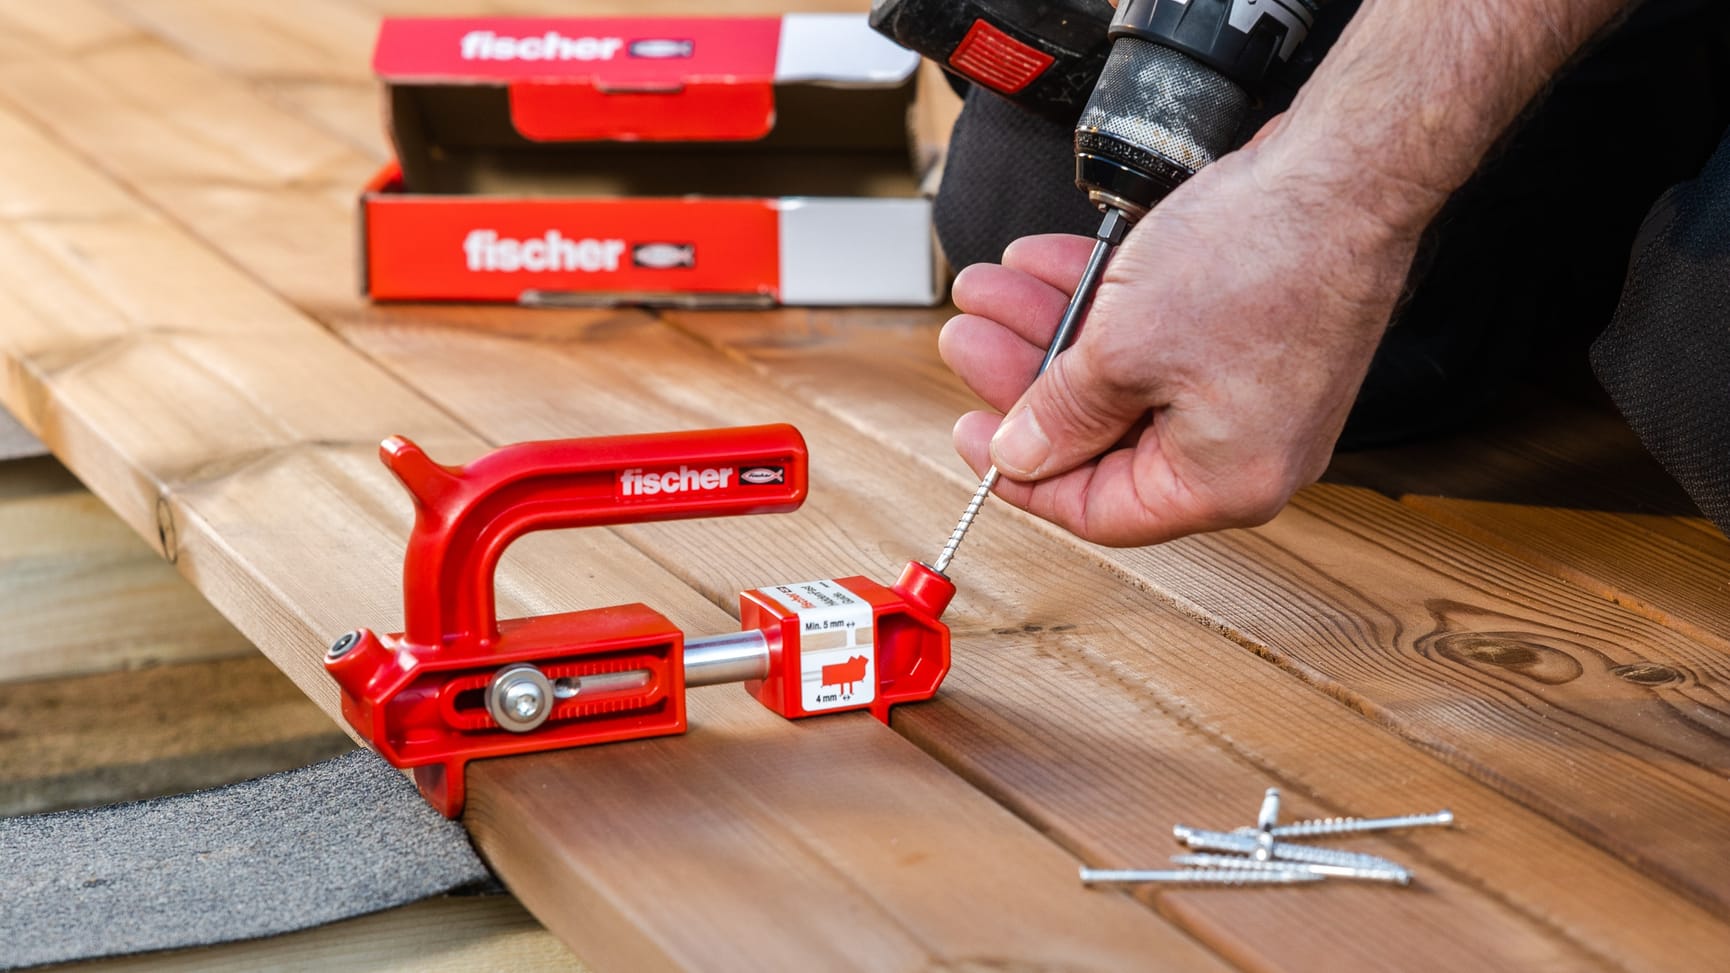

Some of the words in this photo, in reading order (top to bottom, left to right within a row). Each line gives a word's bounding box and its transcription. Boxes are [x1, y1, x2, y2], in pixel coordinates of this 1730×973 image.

[461, 31, 623, 60] fischer
[463, 229, 626, 272] fischer
[620, 465, 733, 496] fischer
[805, 622, 822, 631] Min.
[823, 620, 829, 629] 5
[829, 620, 844, 628] mm
[815, 694, 822, 703] 4
[822, 694, 838, 702] mm
